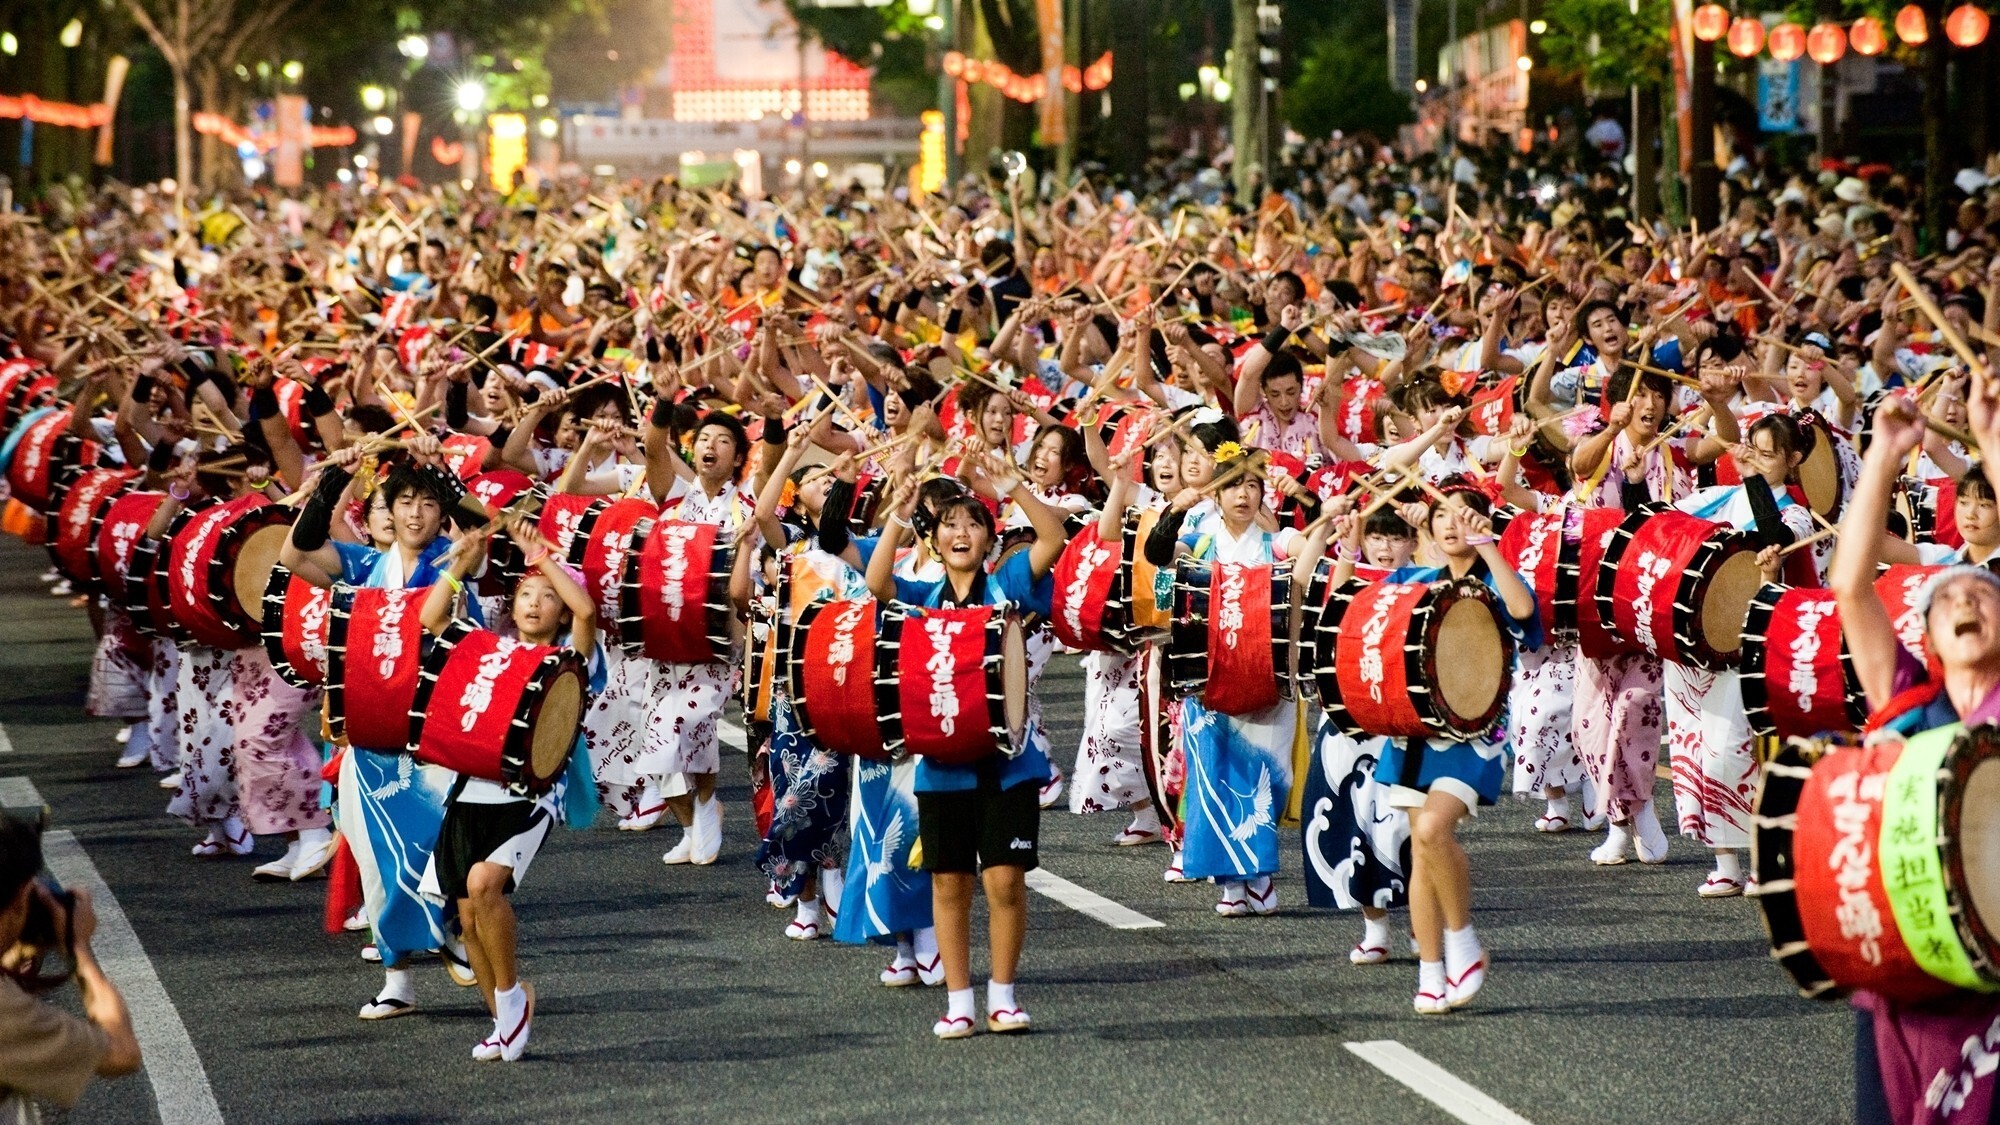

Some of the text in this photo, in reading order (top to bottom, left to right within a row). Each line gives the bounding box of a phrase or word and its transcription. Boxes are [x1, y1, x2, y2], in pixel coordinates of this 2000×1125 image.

[1218, 561, 1244, 650] さんさ踊り
[460, 634, 518, 732] さんさ踊り
[926, 633, 959, 738] さんさ踊り
[1789, 613, 1821, 713] さんさ踊り
[1829, 800, 1883, 967] さんさ踊り
